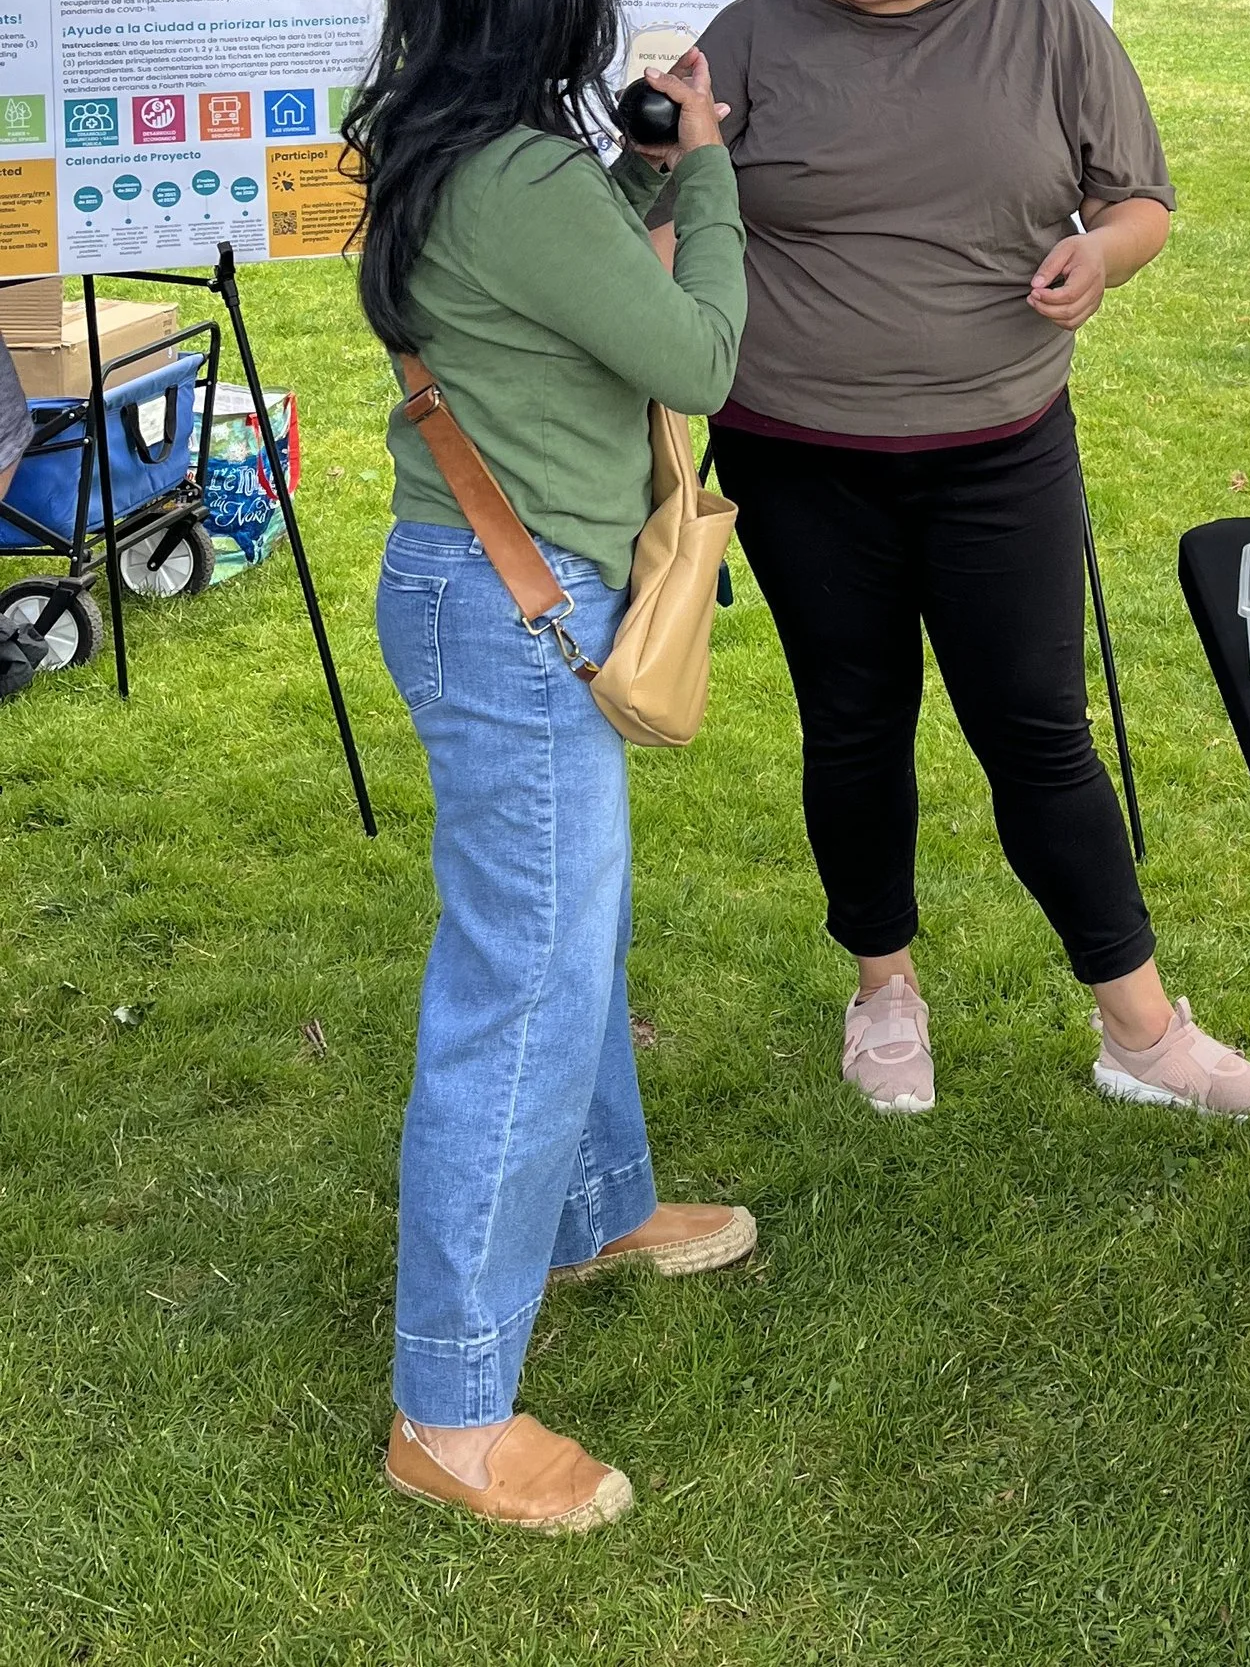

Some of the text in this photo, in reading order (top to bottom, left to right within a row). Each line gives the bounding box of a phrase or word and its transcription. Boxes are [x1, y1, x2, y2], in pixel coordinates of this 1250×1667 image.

[62, 14, 370, 38] ¡Ayude a la Ciudad a priorizar las inversiones!
[1, 41, 24, 49] three
[639, 53, 656, 61] ROSE
[65, 151, 201, 166] Calendario de Proyecto
[270, 150, 328, 163] ¡Participe!
